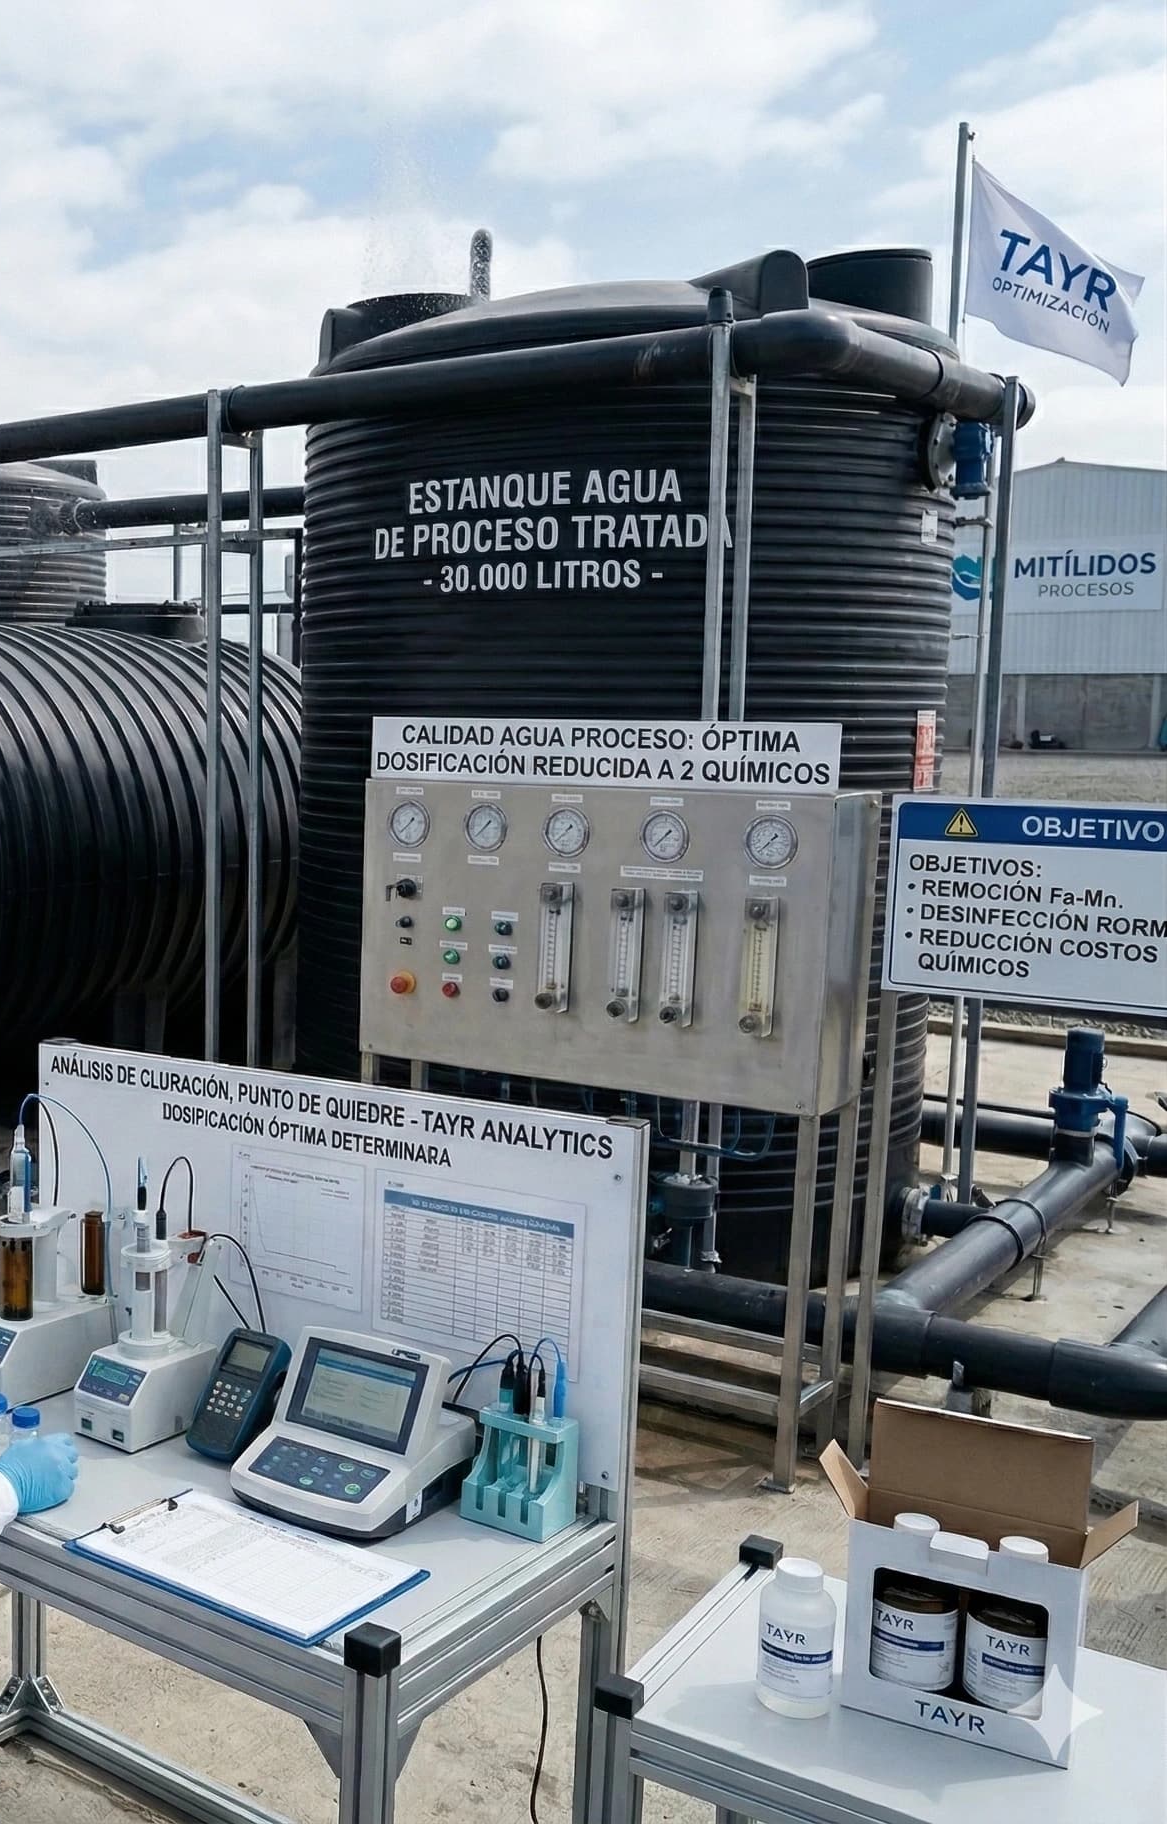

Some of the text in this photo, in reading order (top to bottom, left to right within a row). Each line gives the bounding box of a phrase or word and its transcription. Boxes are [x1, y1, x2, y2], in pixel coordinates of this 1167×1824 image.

[1000, 229, 1117, 313] TAYR
[992, 277, 1110, 334] OPTIMIZACIÓN
[409, 469, 682, 514] ESTANQUE AGUA
[375, 527, 404, 560] DE
[413, 515, 559, 556] PROCESO
[440, 562, 527, 593] 30.000
[537, 559, 641, 590] LITROS
[1014, 549, 1156, 578] MITÍLIDOS
[1038, 582, 1134, 598] PROCESOS
[402, 723, 801, 752] CALIDAD AGUA PROCESO: ÓPTIMA
[376, 749, 830, 785] DOSIFICACIÓN REDUCIDA A 2 QUÍMICOS
[1021, 815, 1165, 843] OBJETIVO
[909, 853, 1042, 878] OBJETIVOS:
[922, 879, 1123, 909] REMOCIÓN Fa-Mn.
[920, 903, 1088, 932] DESINFECCIÓN
[919, 928, 1158, 963] REDUCCIÓN COSTOS
[918, 950, 1030, 978] QUÍMICOS
[51, 1053, 113, 1082] ANÁLISIS
[117, 1065, 136, 1086] DE
[140, 1068, 233, 1104] CLURACIÓN,
[238, 1083, 293, 1110] PUNTO
[299, 1092, 321, 1115] DE
[421, 1109, 475, 1139] TAYR
[481, 1119, 613, 1159] ANALYTICS
[269, 1115, 327, 1146] ÓPTIMA
[766, 1622, 805, 1645] TAYR
[875, 1608, 914, 1631] TAYR
[986, 1635, 1031, 1656] TAYR
[914, 1700, 985, 1735] TAYR
